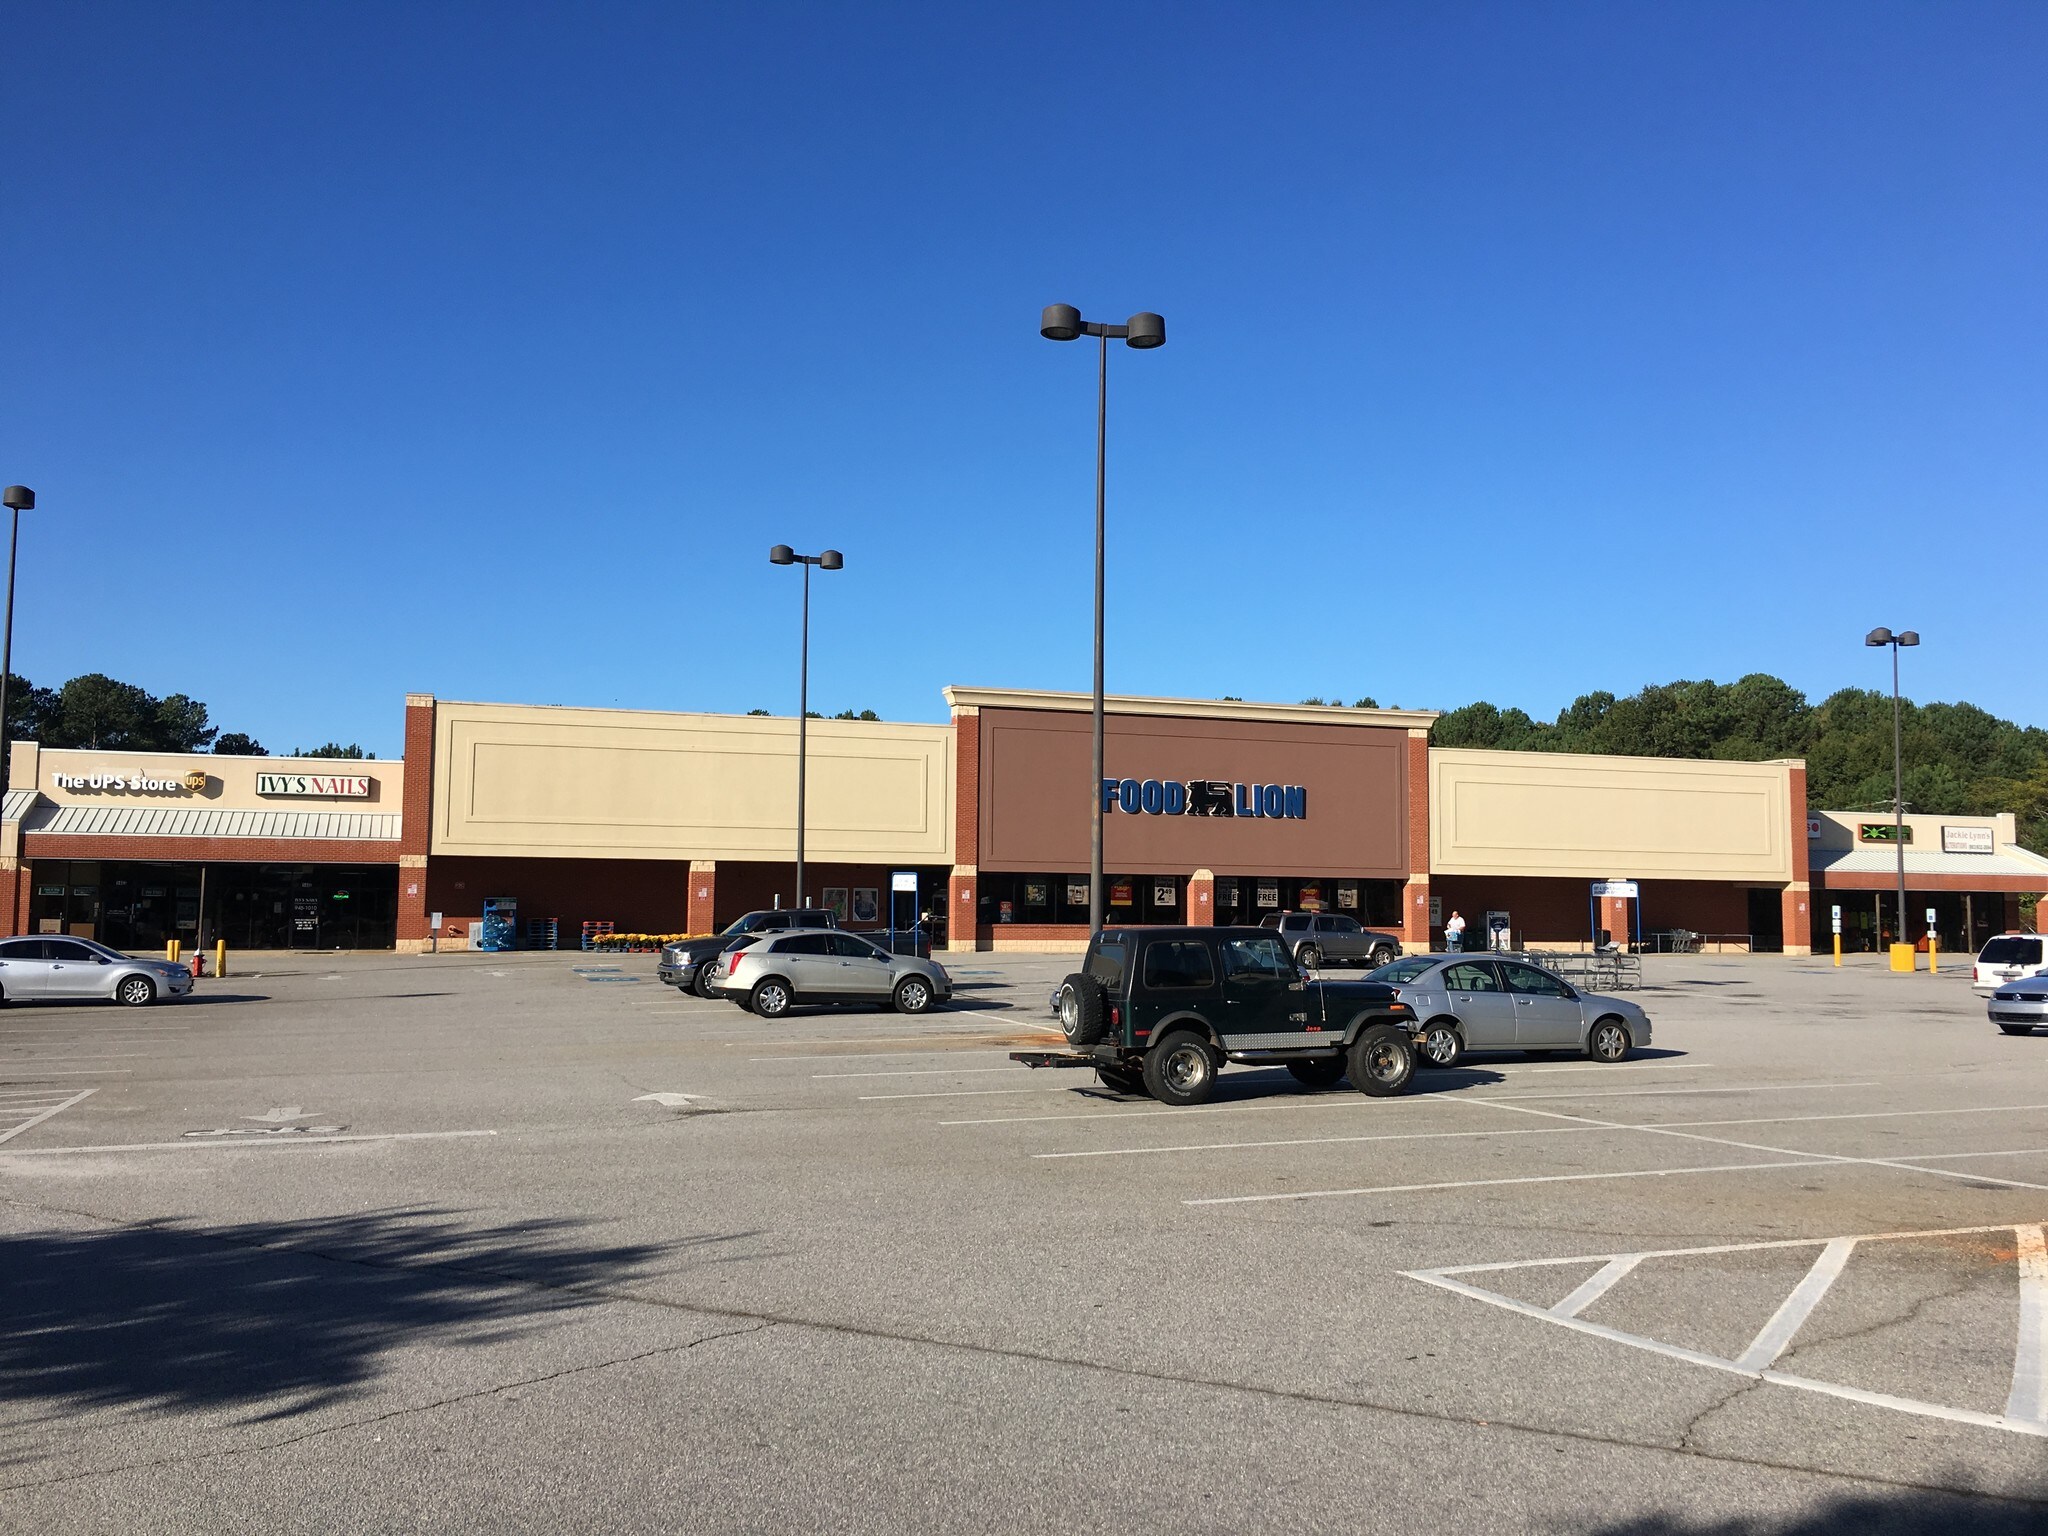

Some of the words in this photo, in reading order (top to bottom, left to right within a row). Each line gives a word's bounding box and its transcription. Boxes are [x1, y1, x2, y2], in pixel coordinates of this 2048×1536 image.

[52, 772, 84, 788] The
[90, 773, 126, 790] UPS
[130, 775, 176, 791] Store
[186, 775, 204, 788] ups
[260, 775, 306, 794] IVY'S
[311, 777, 367, 795] NAILS
[1102, 777, 1186, 815] FOOD
[1233, 782, 1306, 819] LION
[1945, 830, 1969, 840] Jackie
[1258, 893, 1277, 902] FREE
